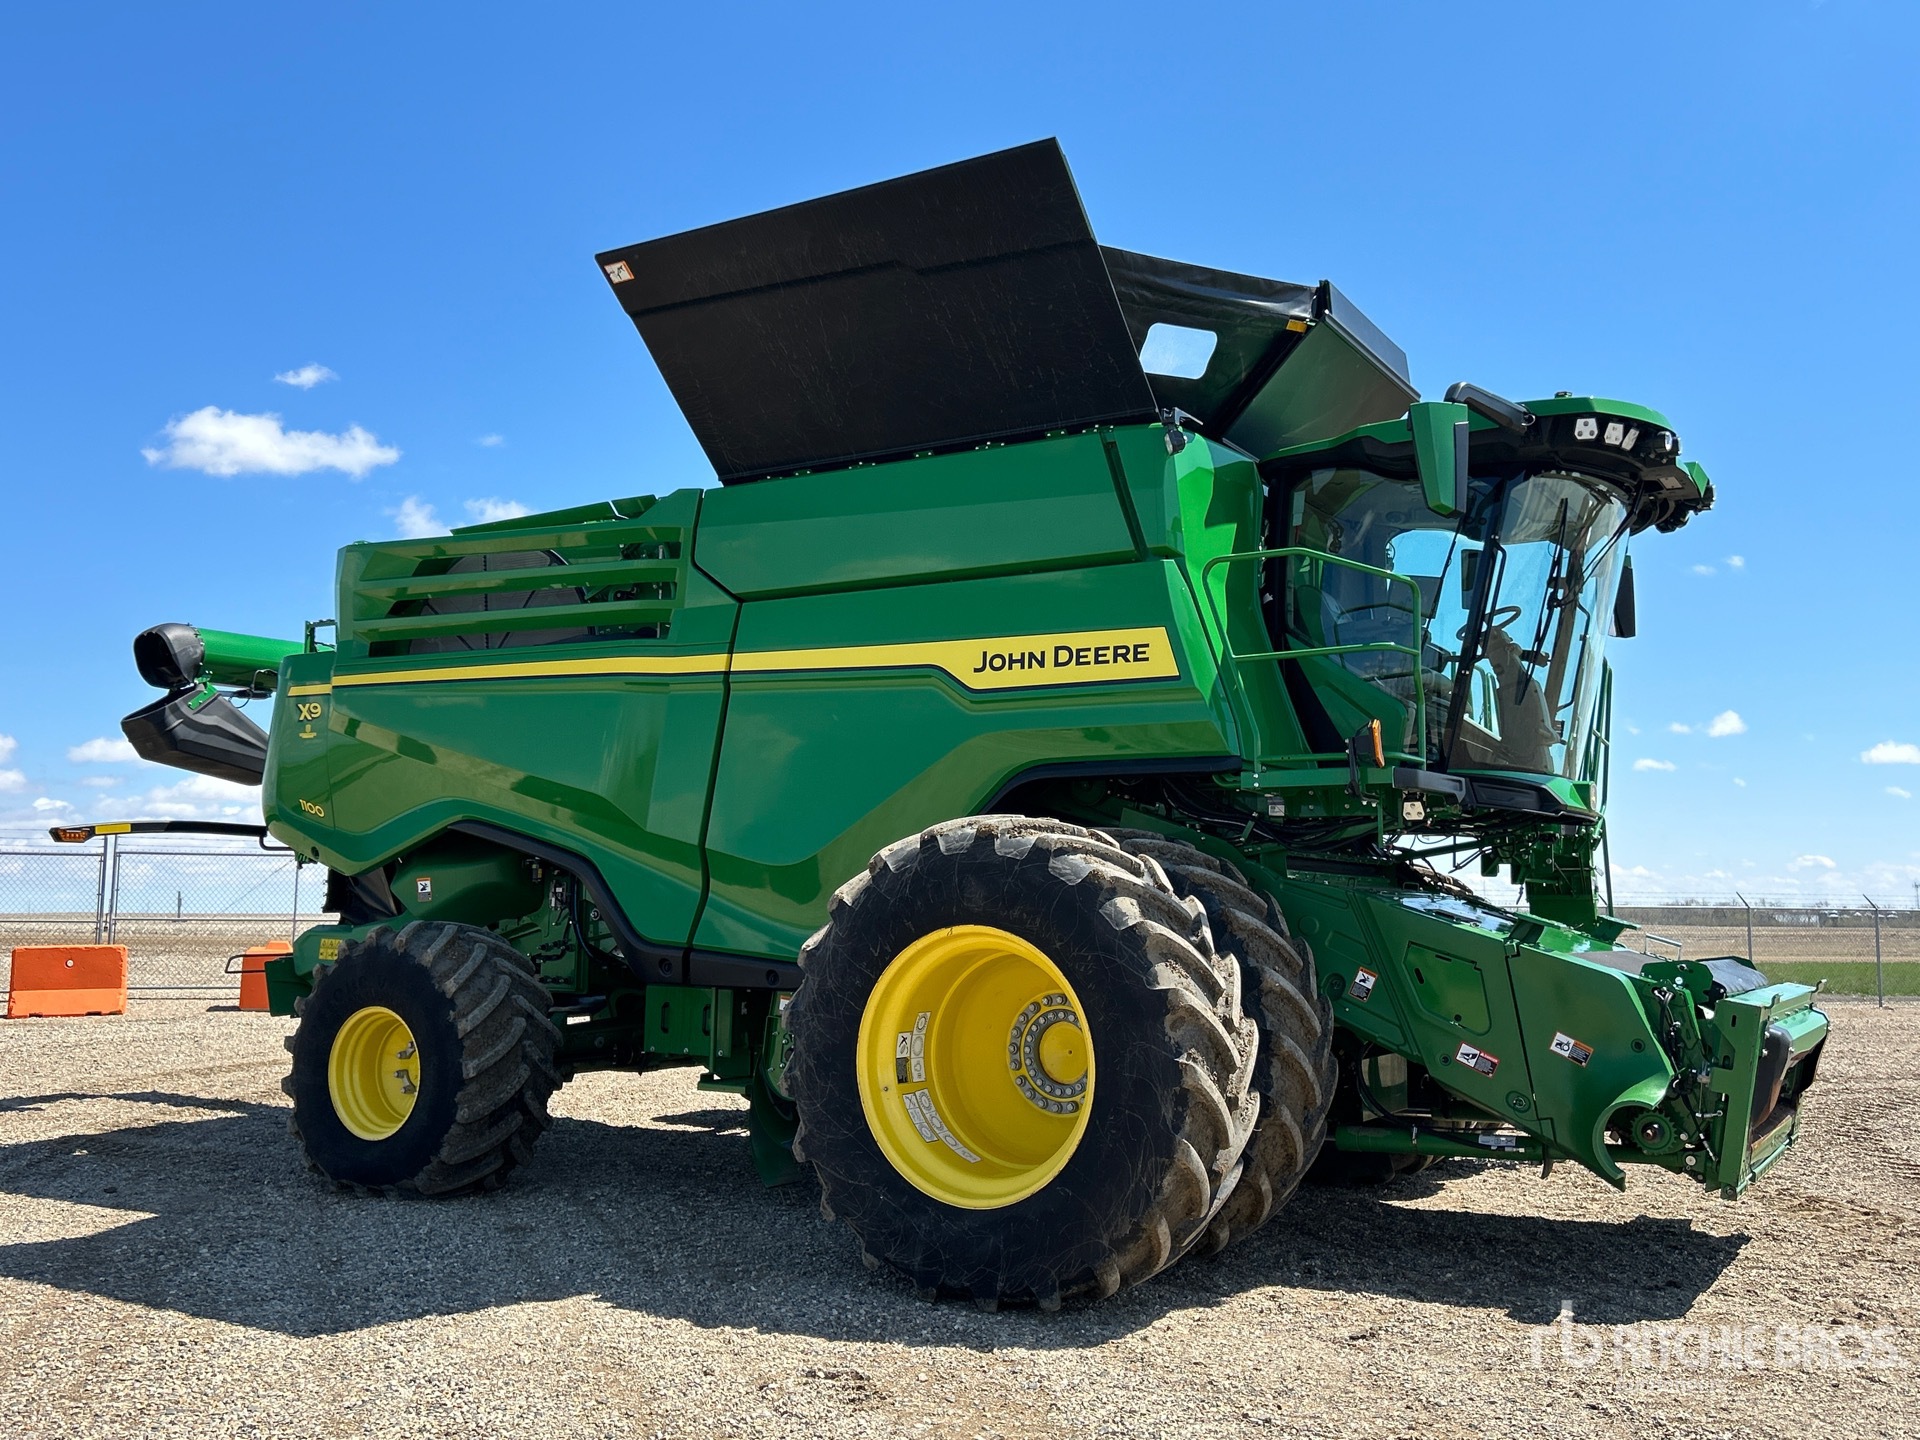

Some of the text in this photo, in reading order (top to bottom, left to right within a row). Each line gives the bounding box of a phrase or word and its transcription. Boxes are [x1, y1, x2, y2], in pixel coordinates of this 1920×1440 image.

[973, 643, 1150, 673] JOHN DEERE
[298, 702, 322, 721] X9
[299, 799, 325, 818] 1100
